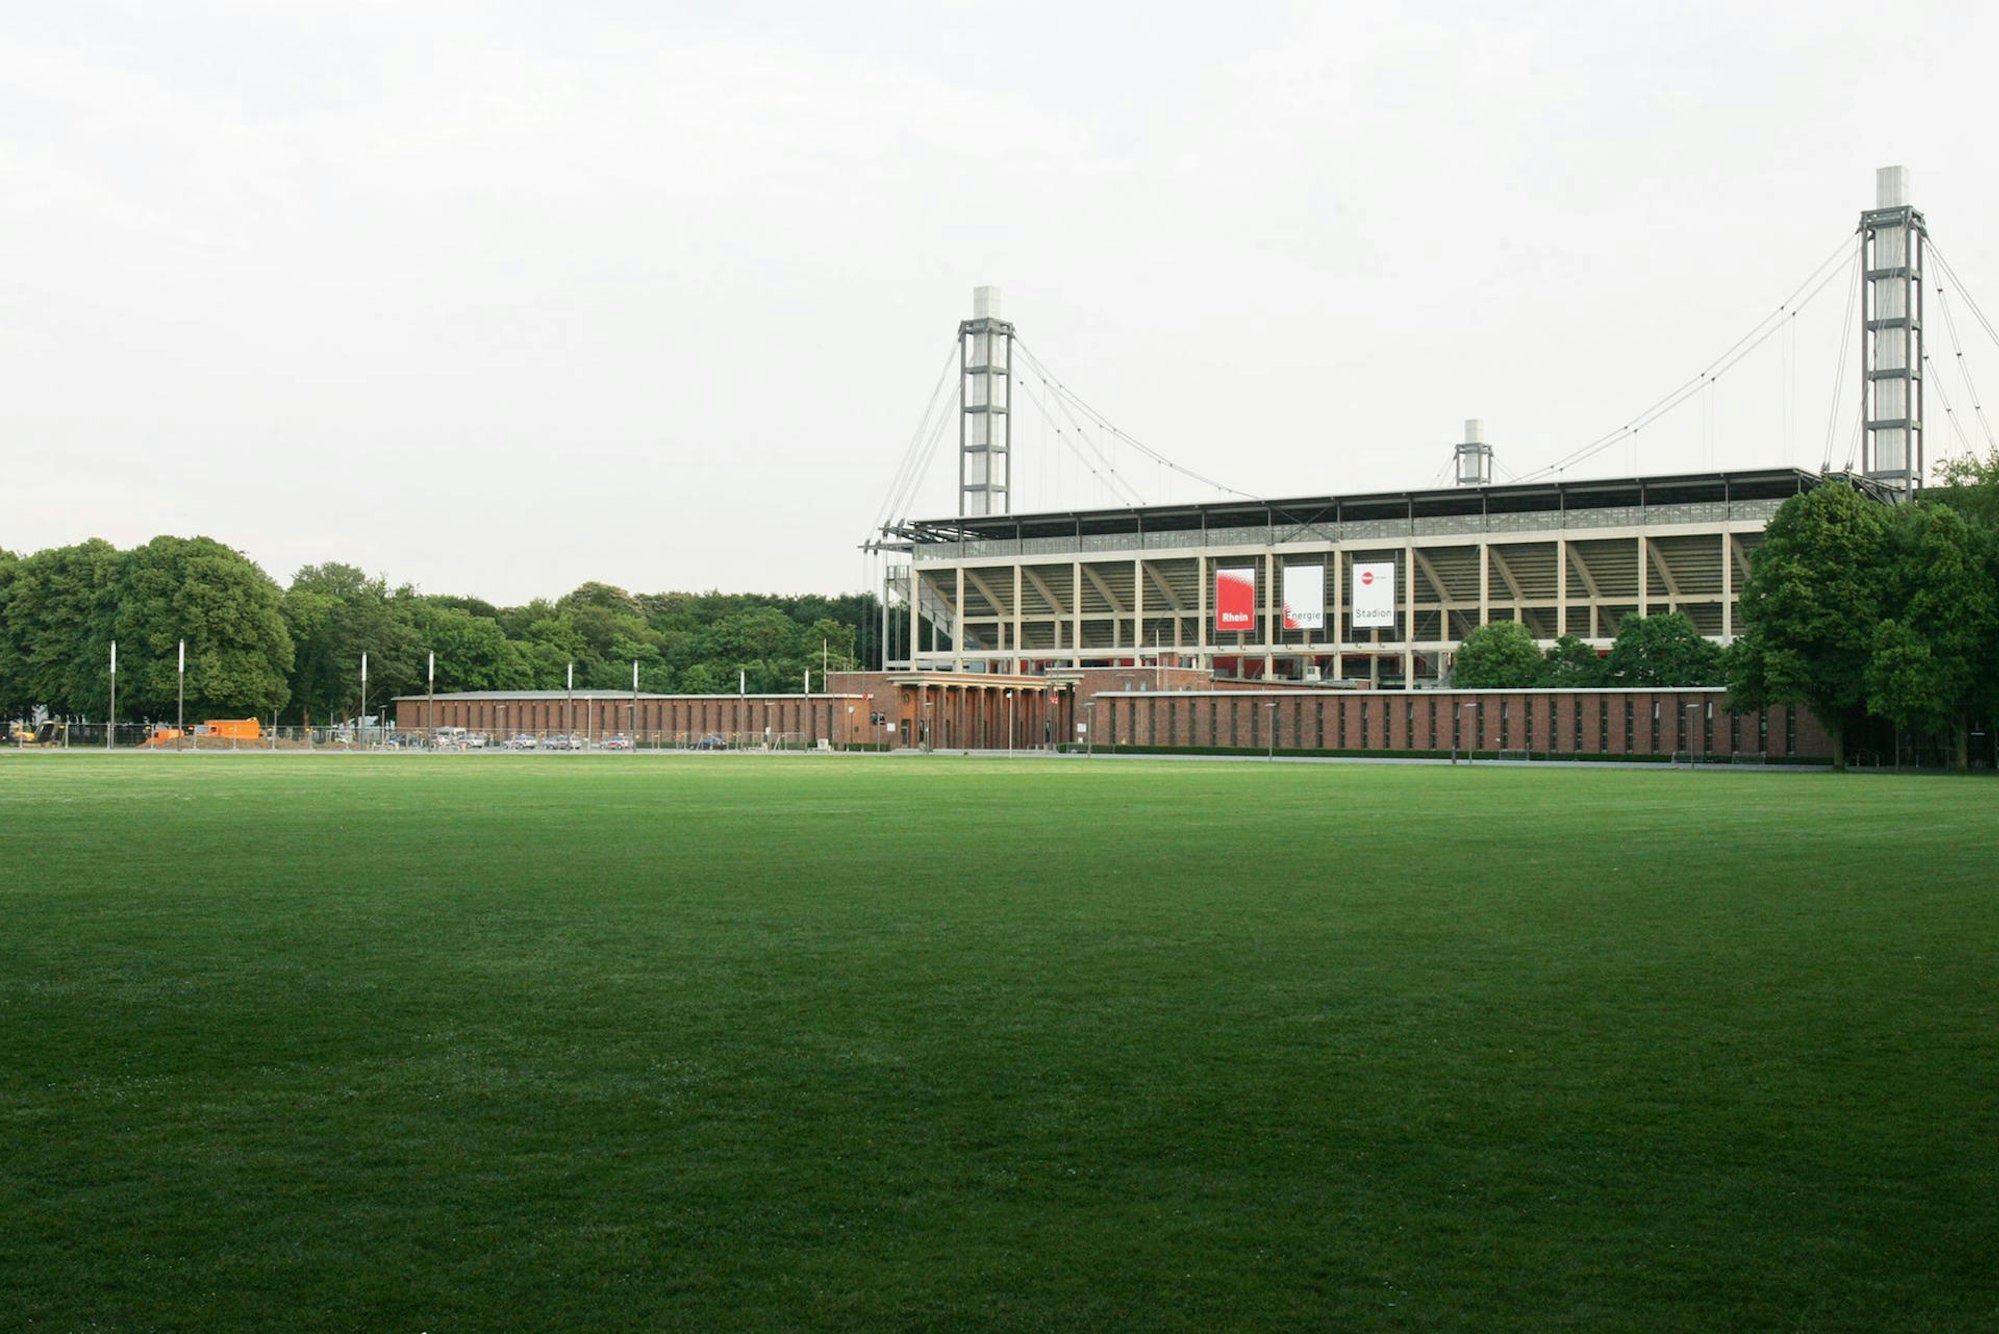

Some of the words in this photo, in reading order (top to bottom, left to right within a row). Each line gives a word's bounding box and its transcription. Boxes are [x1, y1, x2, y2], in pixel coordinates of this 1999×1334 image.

[1222, 612, 1248, 622] Rhein
[1285, 610, 1321, 621] Energie
[1356, 608, 1391, 618] Stadion
